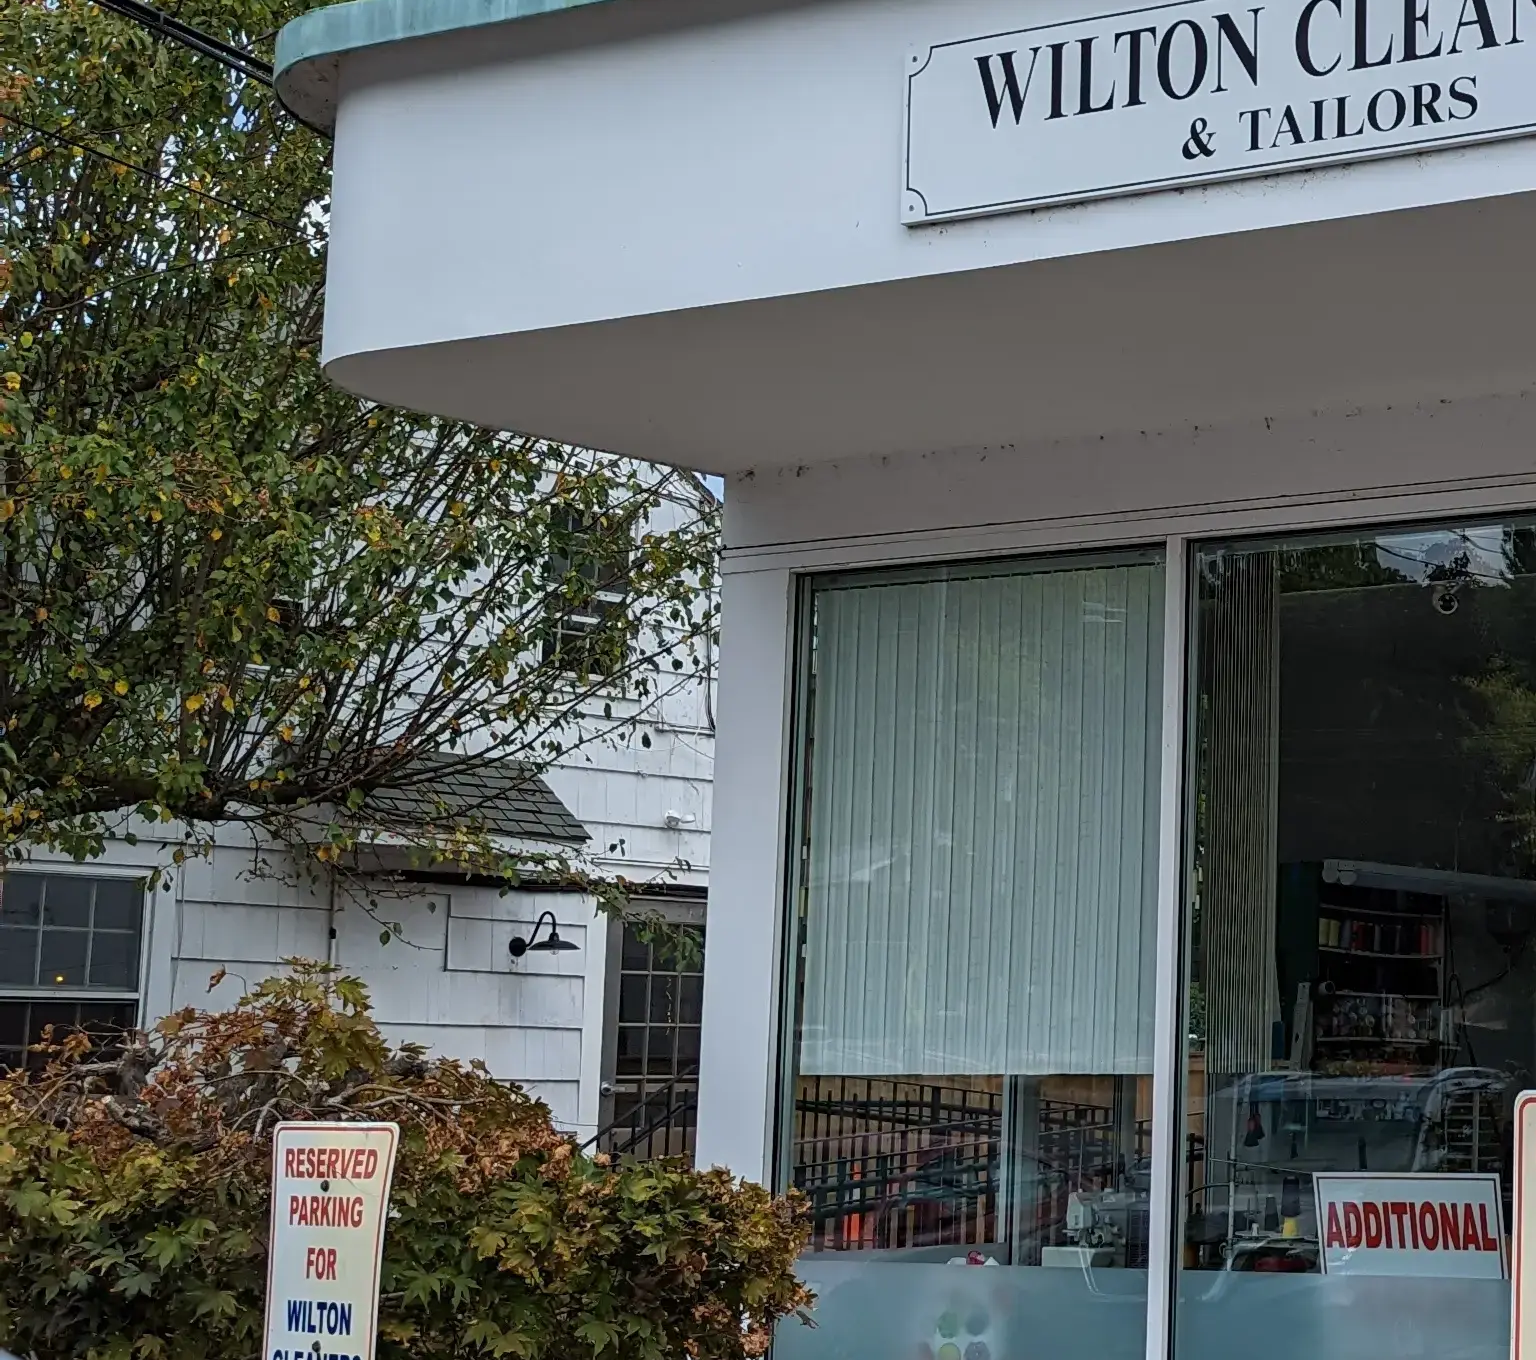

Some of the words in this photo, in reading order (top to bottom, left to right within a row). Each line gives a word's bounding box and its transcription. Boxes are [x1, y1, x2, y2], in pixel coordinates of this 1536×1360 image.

[975, 7, 1266, 129] WILTON
[1182, 116, 1217, 160] &
[1239, 76, 1479, 151] TAILORS
[285, 1148, 377, 1179] RESERVED
[289, 1196, 363, 1228] PARKING
[1327, 1201, 1497, 1252] ADDITIONAL
[306, 1247, 336, 1280] FOR
[287, 1300, 352, 1335] WILTON
